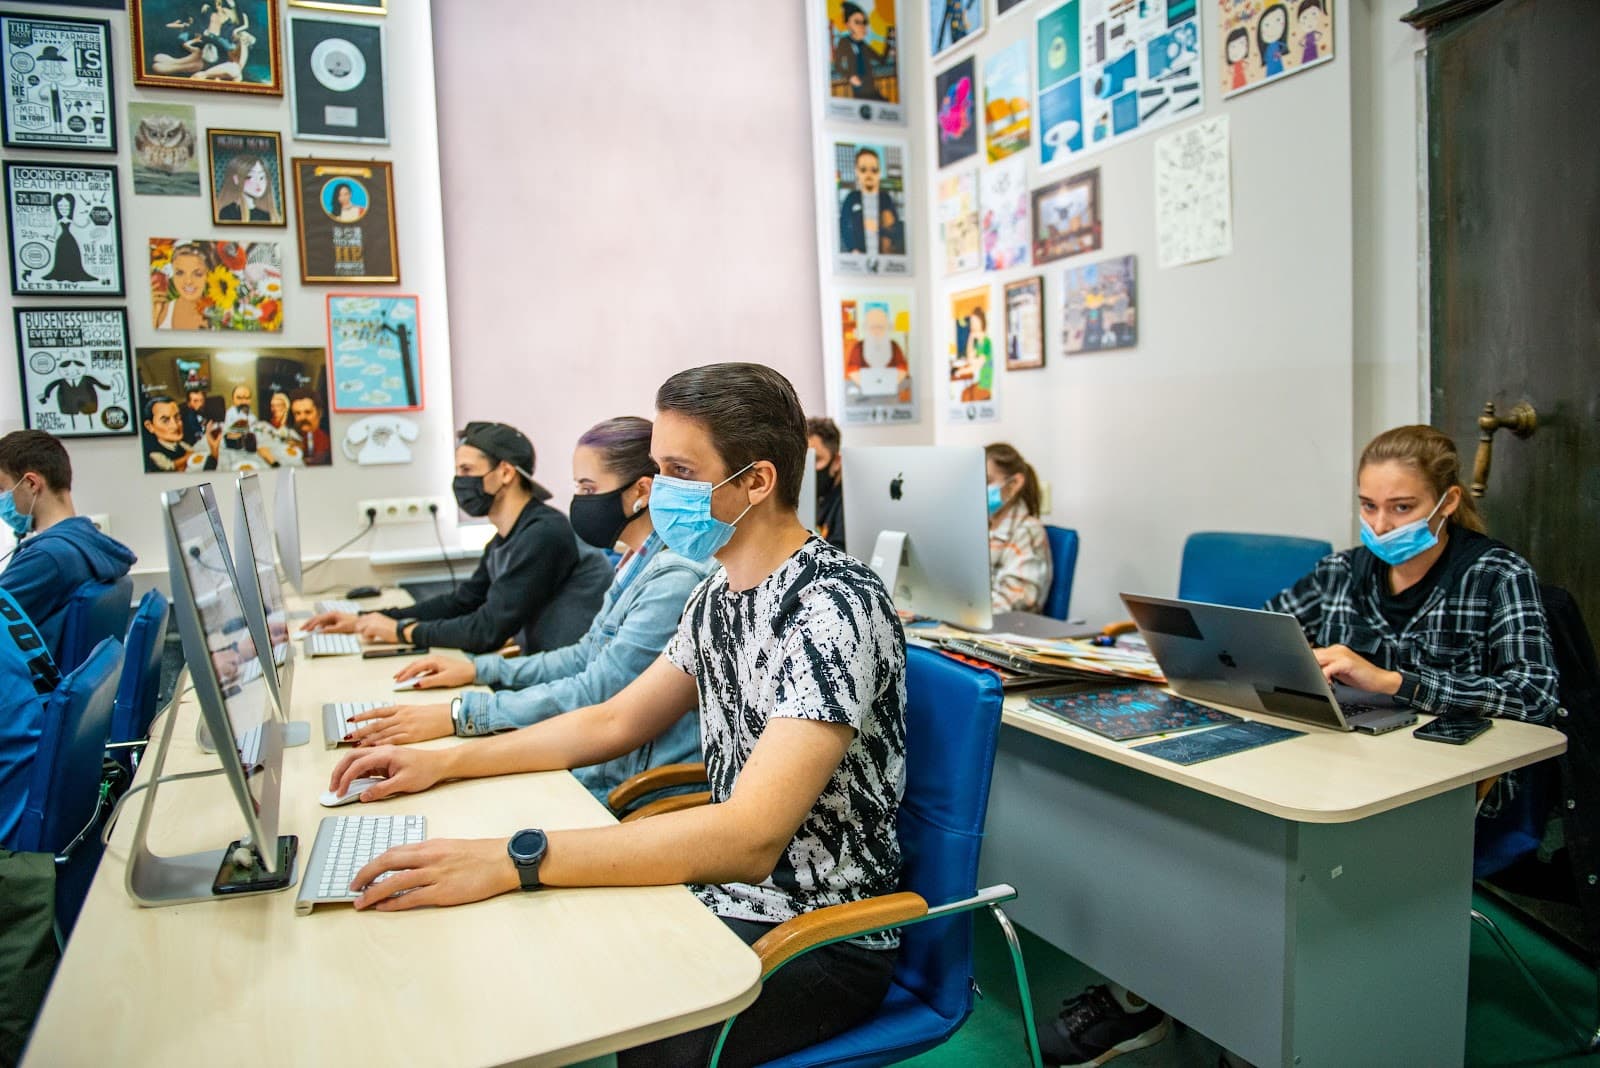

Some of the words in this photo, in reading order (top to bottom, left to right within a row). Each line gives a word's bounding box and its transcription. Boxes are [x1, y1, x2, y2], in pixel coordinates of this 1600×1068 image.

[9, 23, 31, 32] THE
[33, 31, 57, 39] EVEN
[60, 32, 100, 41] FARMERS
[76, 48, 101, 70] IS
[77, 69, 101, 77] TASTY
[12, 85, 25, 96] HE
[19, 105, 44, 115] MELT
[15, 169, 63, 181] LOOKING
[64, 171, 87, 182] FOR
[14, 179, 88, 191] BEAUTIFULL
[21, 282, 52, 290] LET'S
[26, 312, 81, 329] BUISENESS
[82, 312, 120, 323] LUNCH
[29, 330, 58, 339] EVERY
[60, 330, 80, 338] DAY
